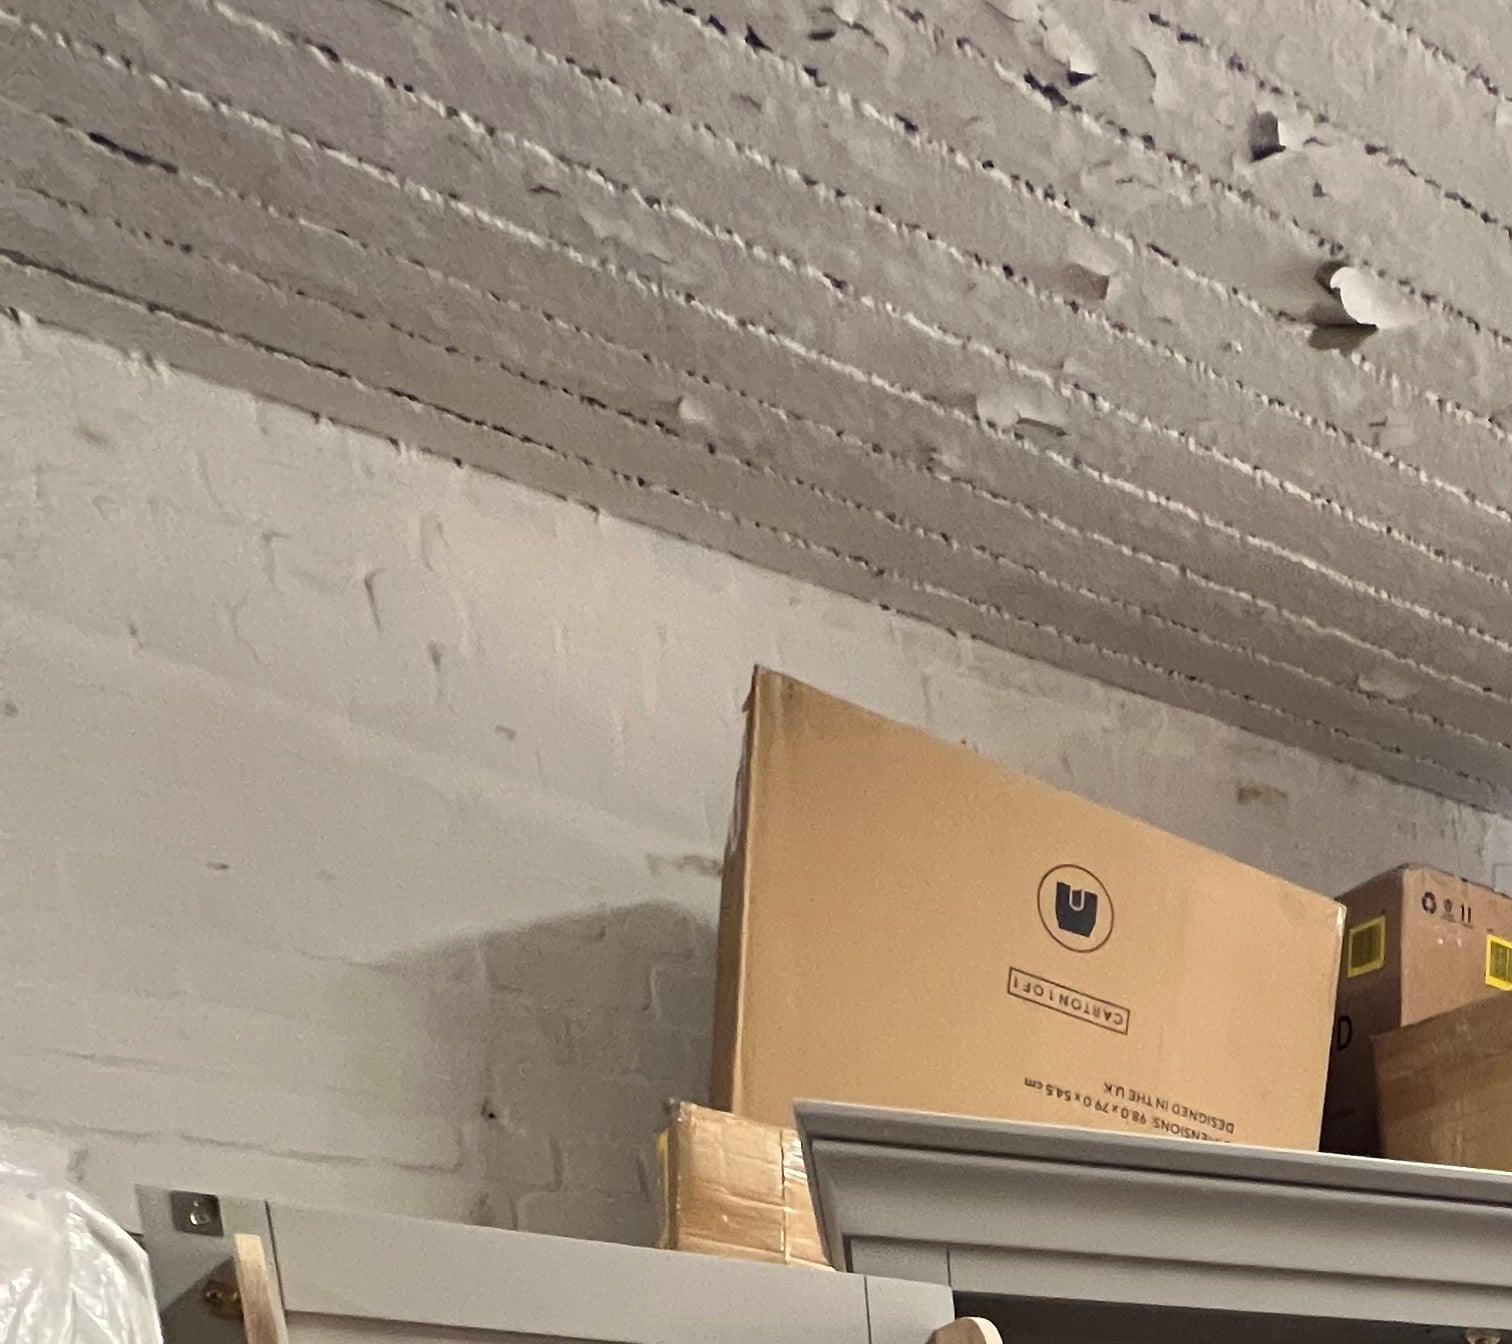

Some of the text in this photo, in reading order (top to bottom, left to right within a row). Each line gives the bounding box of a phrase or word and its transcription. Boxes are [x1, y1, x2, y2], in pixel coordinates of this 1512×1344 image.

[1012, 976, 1123, 1026] CARTON 1 OF 1
[1024, 1076, 1043, 1089] cm
[1129, 1087, 1153, 1107] THE
[1156, 1097, 1170, 1112] IN
[1151, 1117, 1231, 1143] ENSIONS:
[1171, 1103, 1234, 1134] DESIGNED
